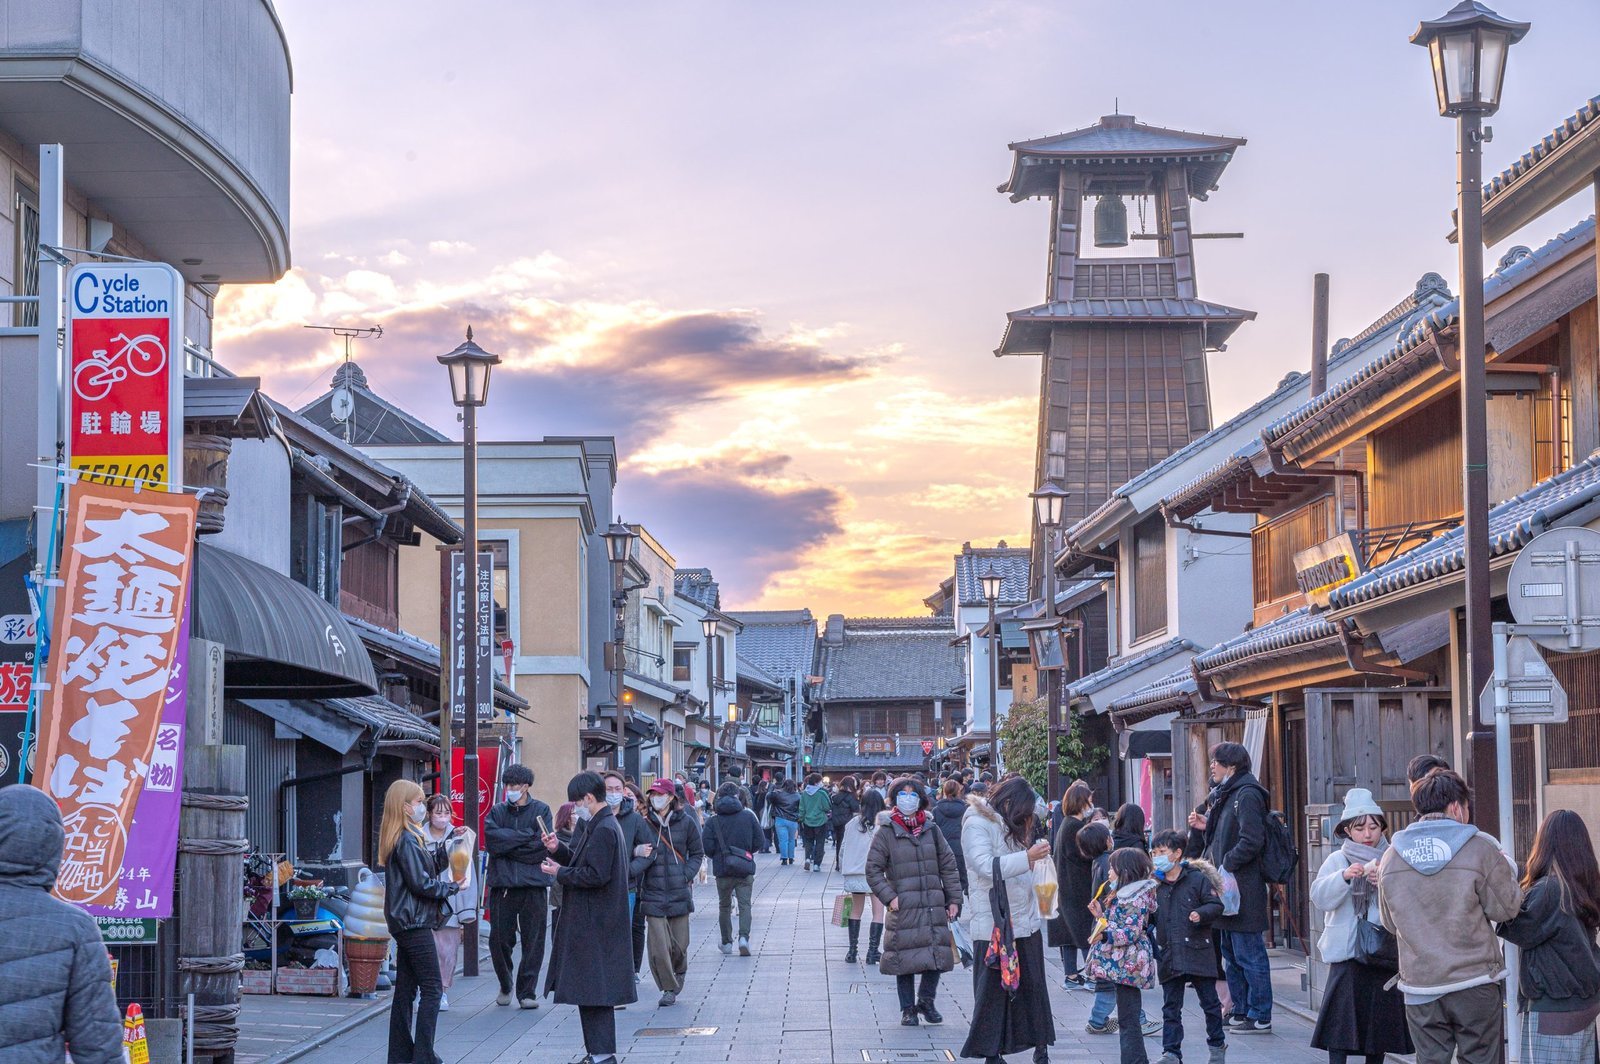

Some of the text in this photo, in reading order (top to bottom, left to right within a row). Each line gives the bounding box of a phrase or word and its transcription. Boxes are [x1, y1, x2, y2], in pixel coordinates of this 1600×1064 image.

[74, 272, 140, 314] Cycle
[103, 295, 168, 313] Station
[81, 411, 162, 435] 駐輪場
[1296, 554, 1348, 594] STARBUCKS
[150, 728, 178, 788] 名物
[1402, 846, 1433, 858] NORTH
[1414, 837, 1432, 847] THE
[1410, 853, 1433, 864] FACE
